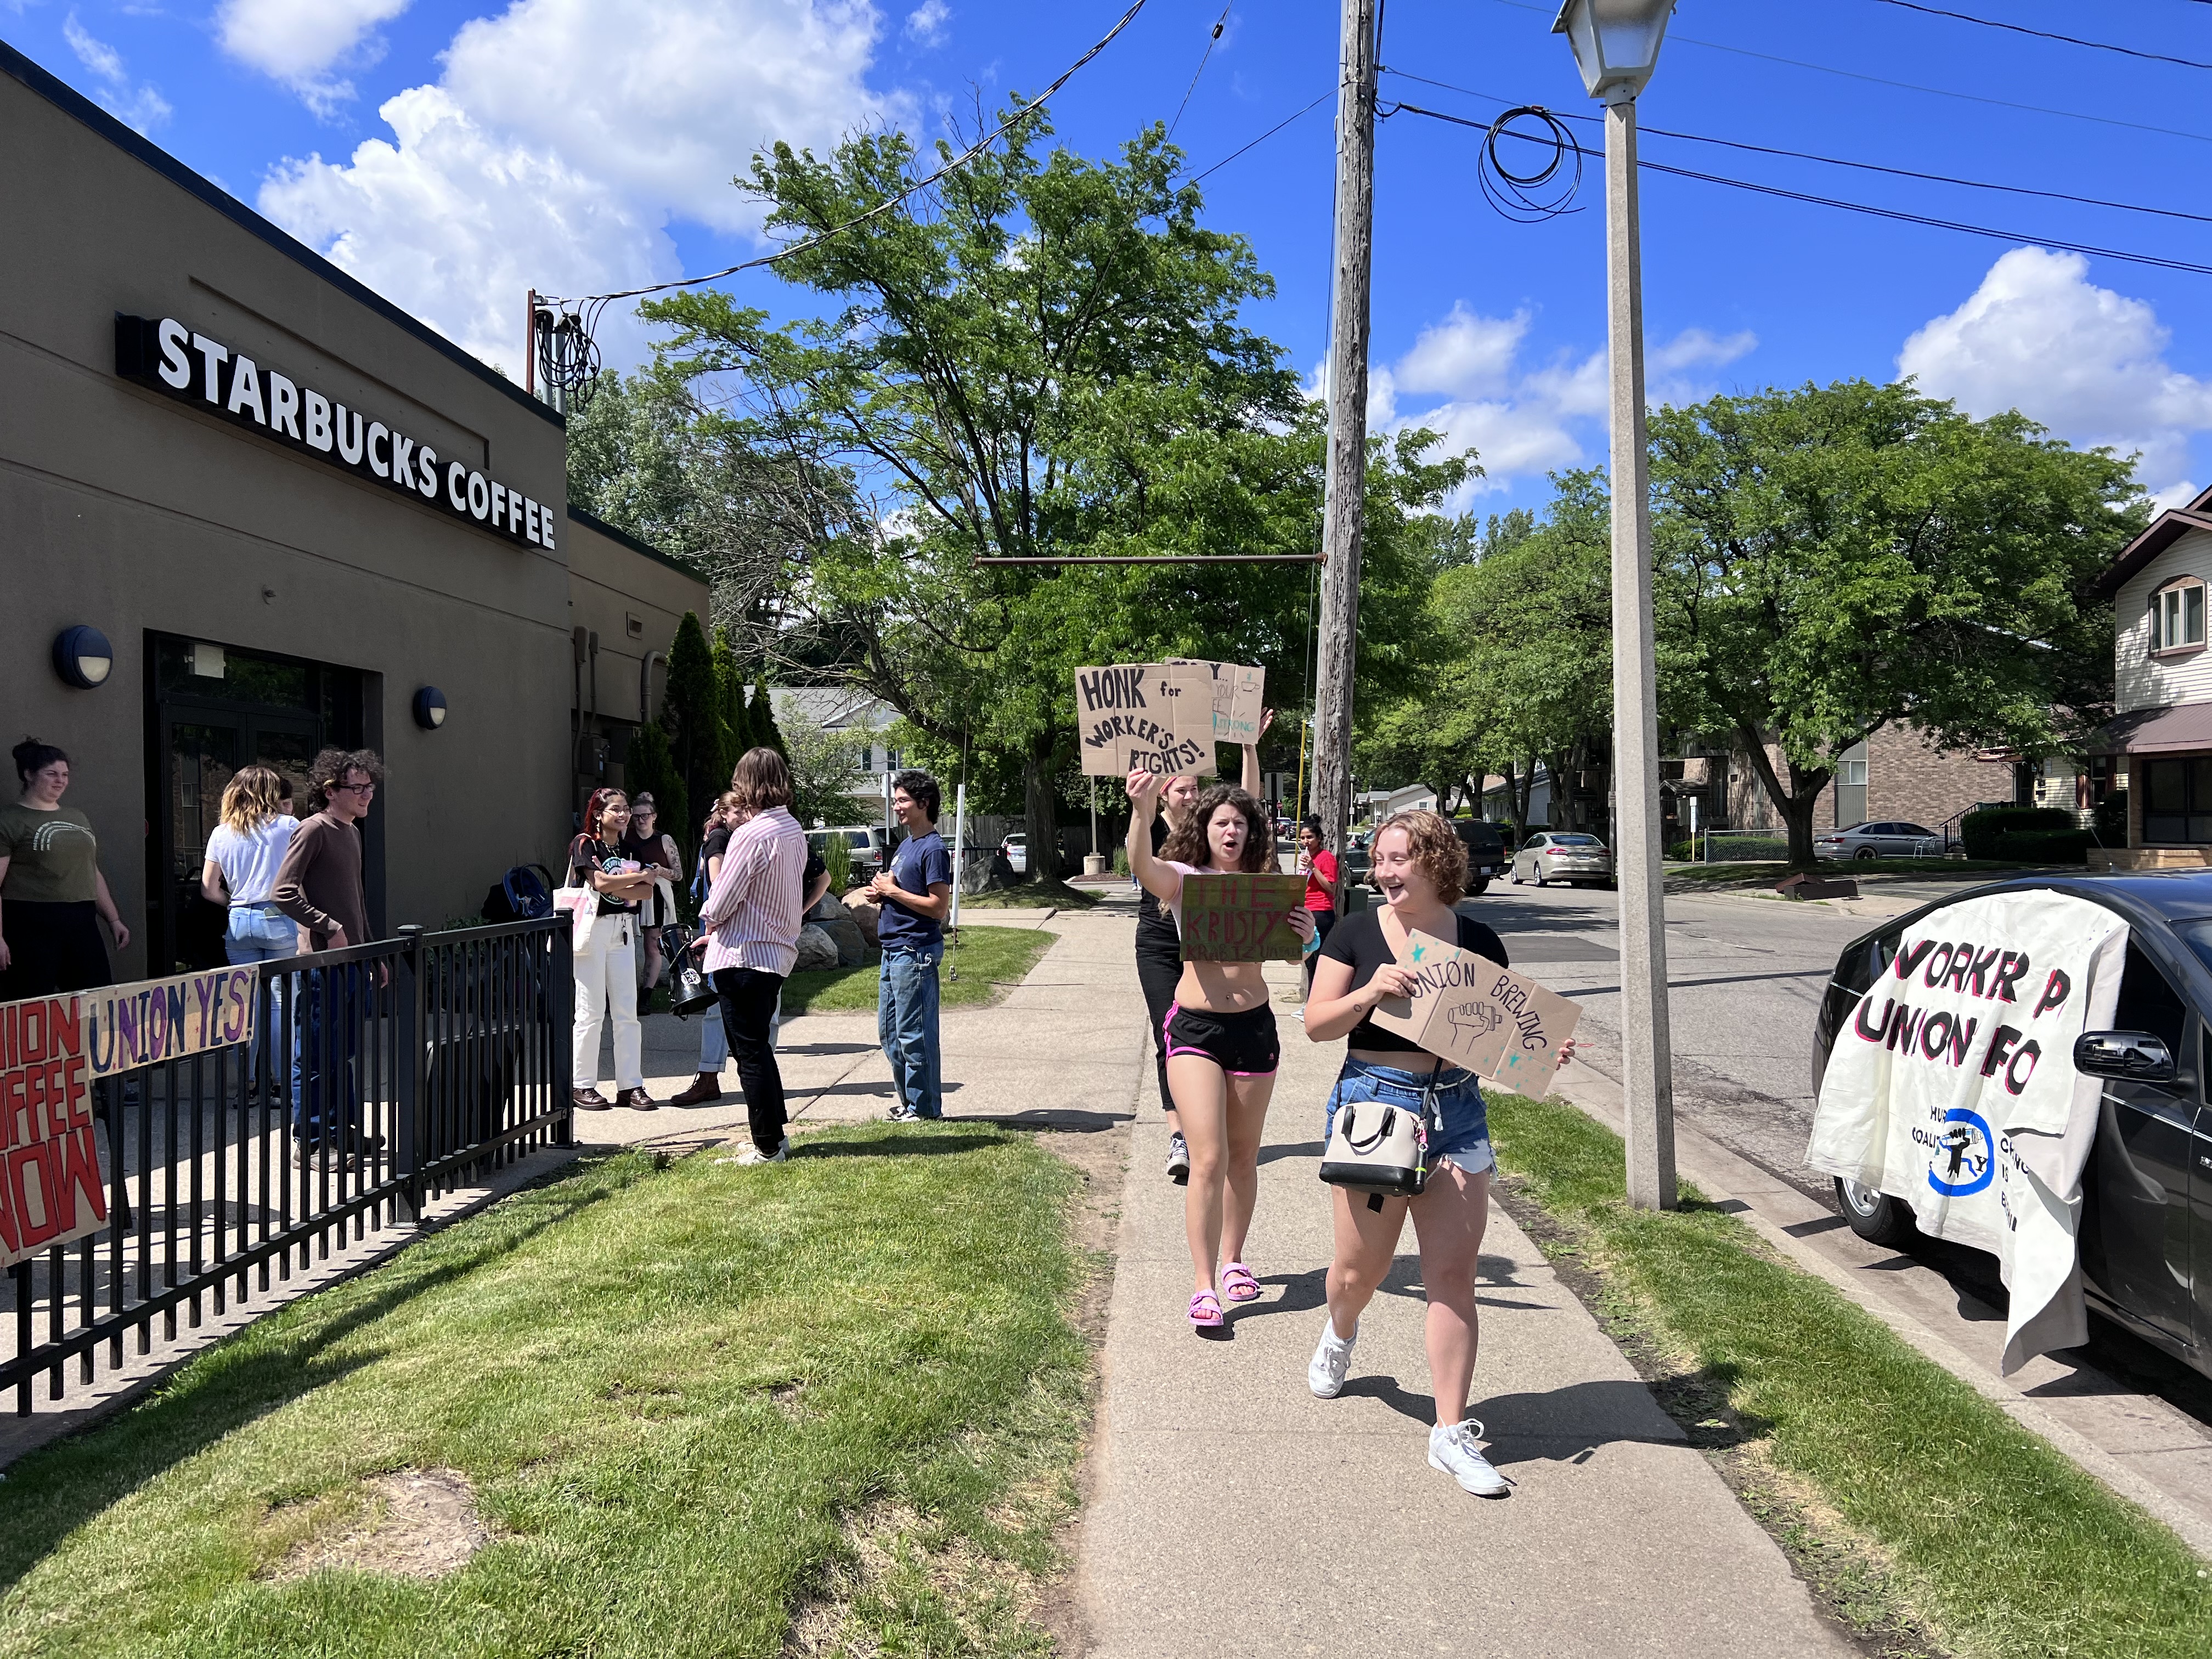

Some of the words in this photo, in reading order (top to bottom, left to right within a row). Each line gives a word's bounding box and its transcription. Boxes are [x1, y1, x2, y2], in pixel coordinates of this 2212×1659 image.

[158, 317, 438, 498] STARBUCKS
[447, 460, 556, 550] COFFEE
[1079, 668, 1147, 712] HONK
[1159, 680, 1182, 697] for
[1215, 683, 1240, 700] YOUR
[1085, 714, 1174, 750] WORKER'S
[1217, 718, 1256, 732] STRONG
[1128, 738, 1205, 774] RIGHTS!
[1192, 877, 1280, 909] THE
[89, 981, 186, 1074] UNION
[194, 970, 257, 1048] YES!
[1489, 975, 1547, 1051] BREWING
